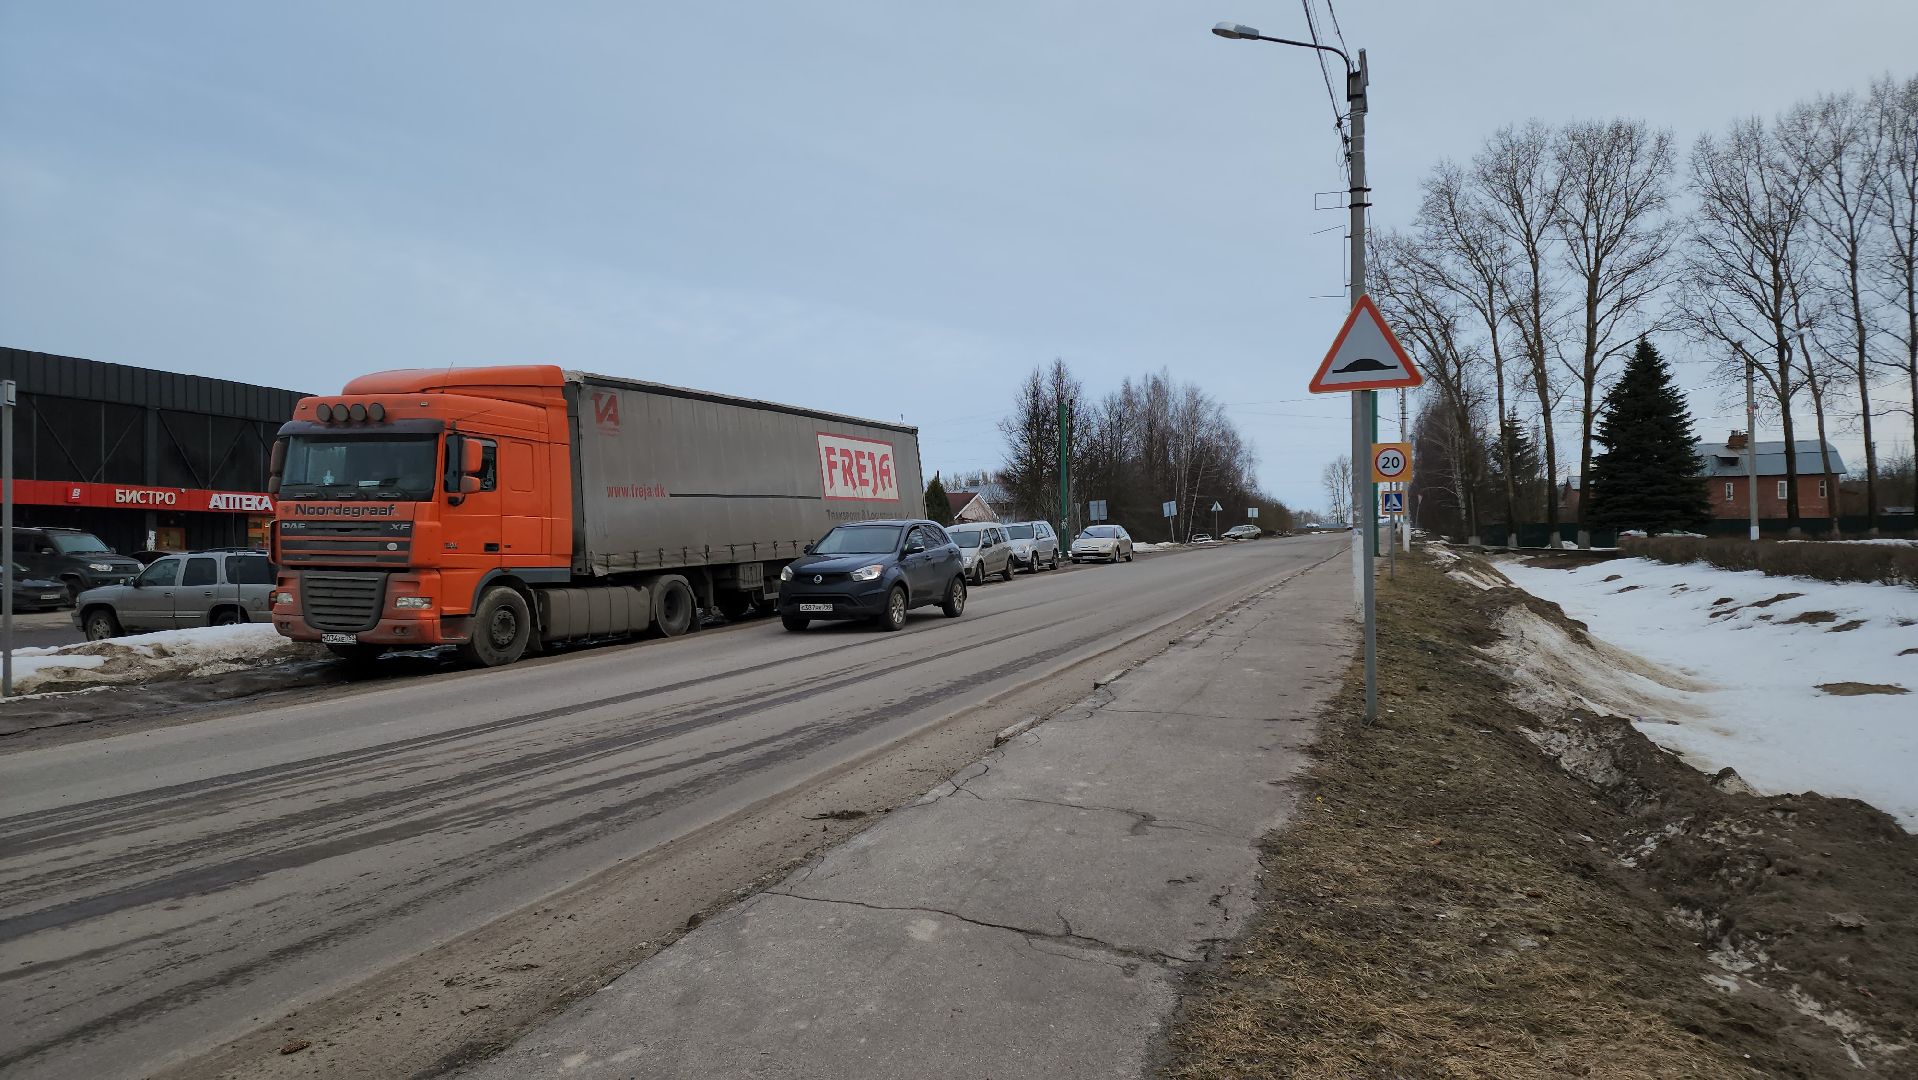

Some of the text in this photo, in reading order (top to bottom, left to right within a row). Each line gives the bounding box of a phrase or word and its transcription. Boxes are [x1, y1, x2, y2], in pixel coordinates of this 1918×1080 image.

[1382, 457, 1400, 469] 20
[825, 447, 892, 496] FREJA
[115, 489, 176, 504] БИСТРО
[607, 483, 665, 501] www.freja.dk
[209, 493, 273, 511] АПТЕКА
[295, 504, 395, 518] Noordegraaf
